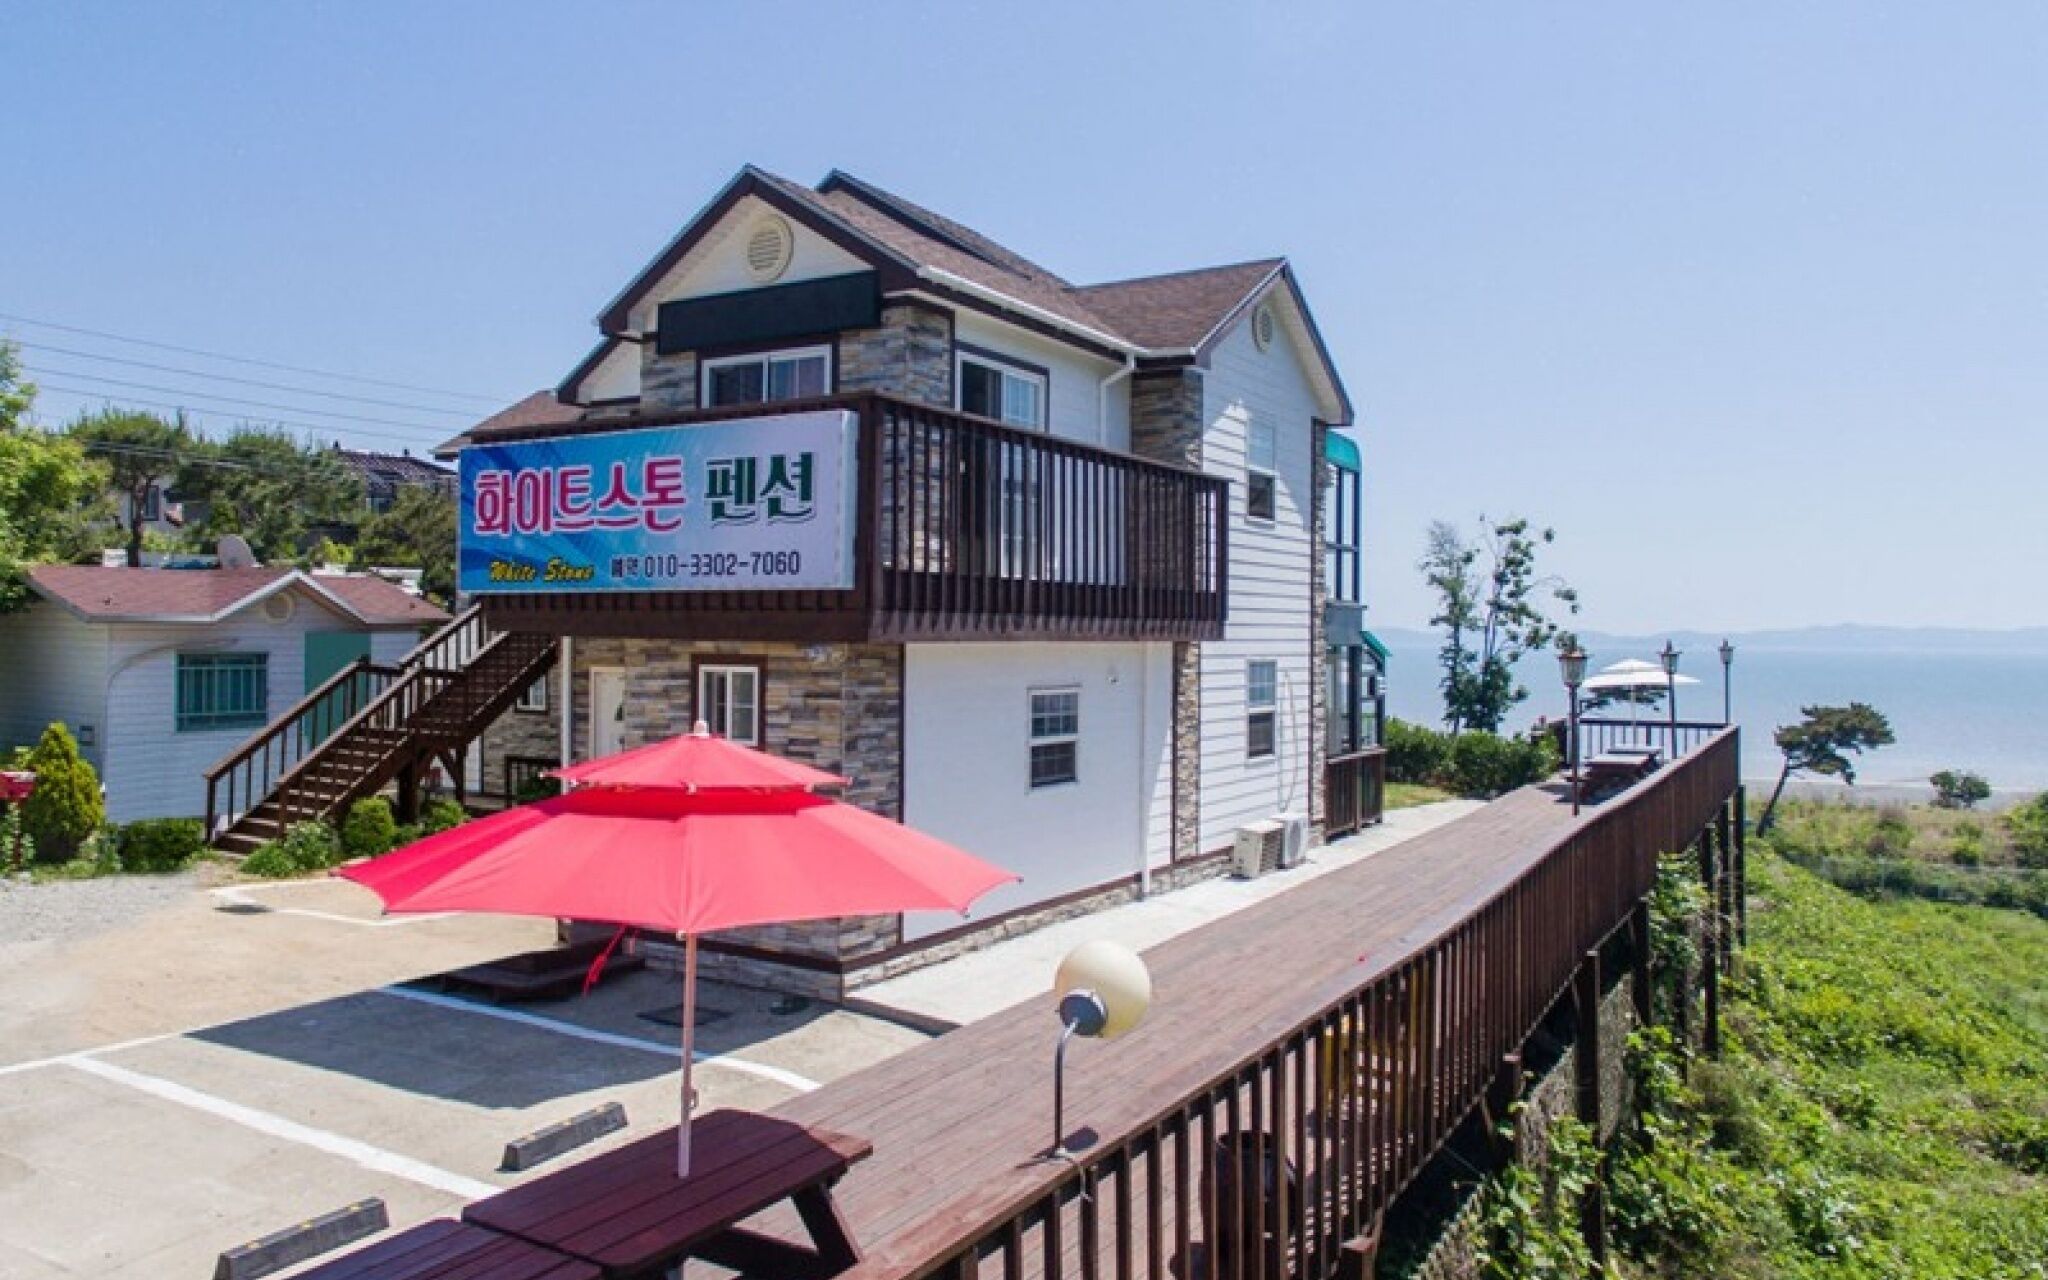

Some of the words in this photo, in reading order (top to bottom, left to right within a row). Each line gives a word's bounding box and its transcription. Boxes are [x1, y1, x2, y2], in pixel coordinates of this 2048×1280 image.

[474, 456, 686, 535] 화이트스톤
[704, 452, 817, 526] 펜션
[490, 558, 536, 582] White
[543, 556, 595, 582] Stone
[644, 550, 801, 578] 010-3302-7060
